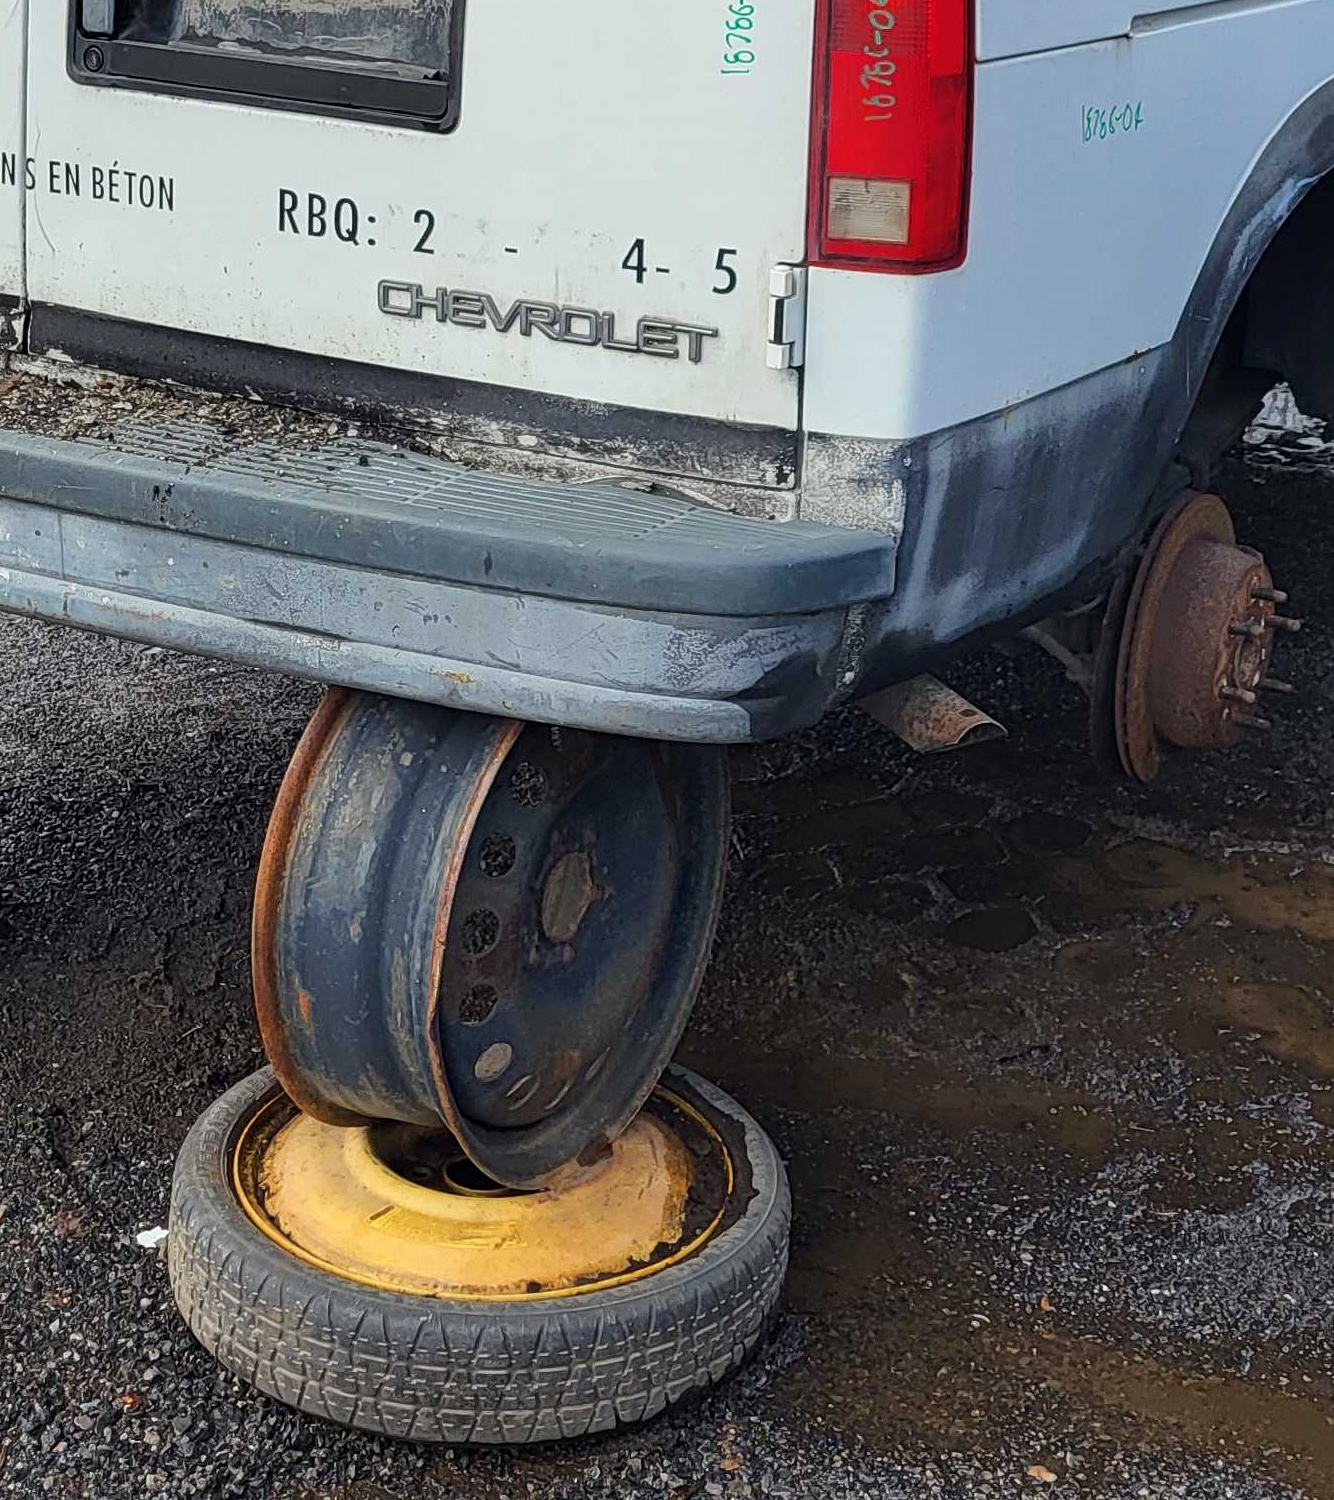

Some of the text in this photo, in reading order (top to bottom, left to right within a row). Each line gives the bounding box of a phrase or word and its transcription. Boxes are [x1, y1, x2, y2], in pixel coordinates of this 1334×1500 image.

[48, 161, 81, 197] EN
[92, 161, 175, 211] BÉTON
[278, 187, 378, 247] RBQ:
[413, 209, 436, 255] 2
[713, 248, 738, 295] 5
[377, 278, 719, 366] CHEVROLET
